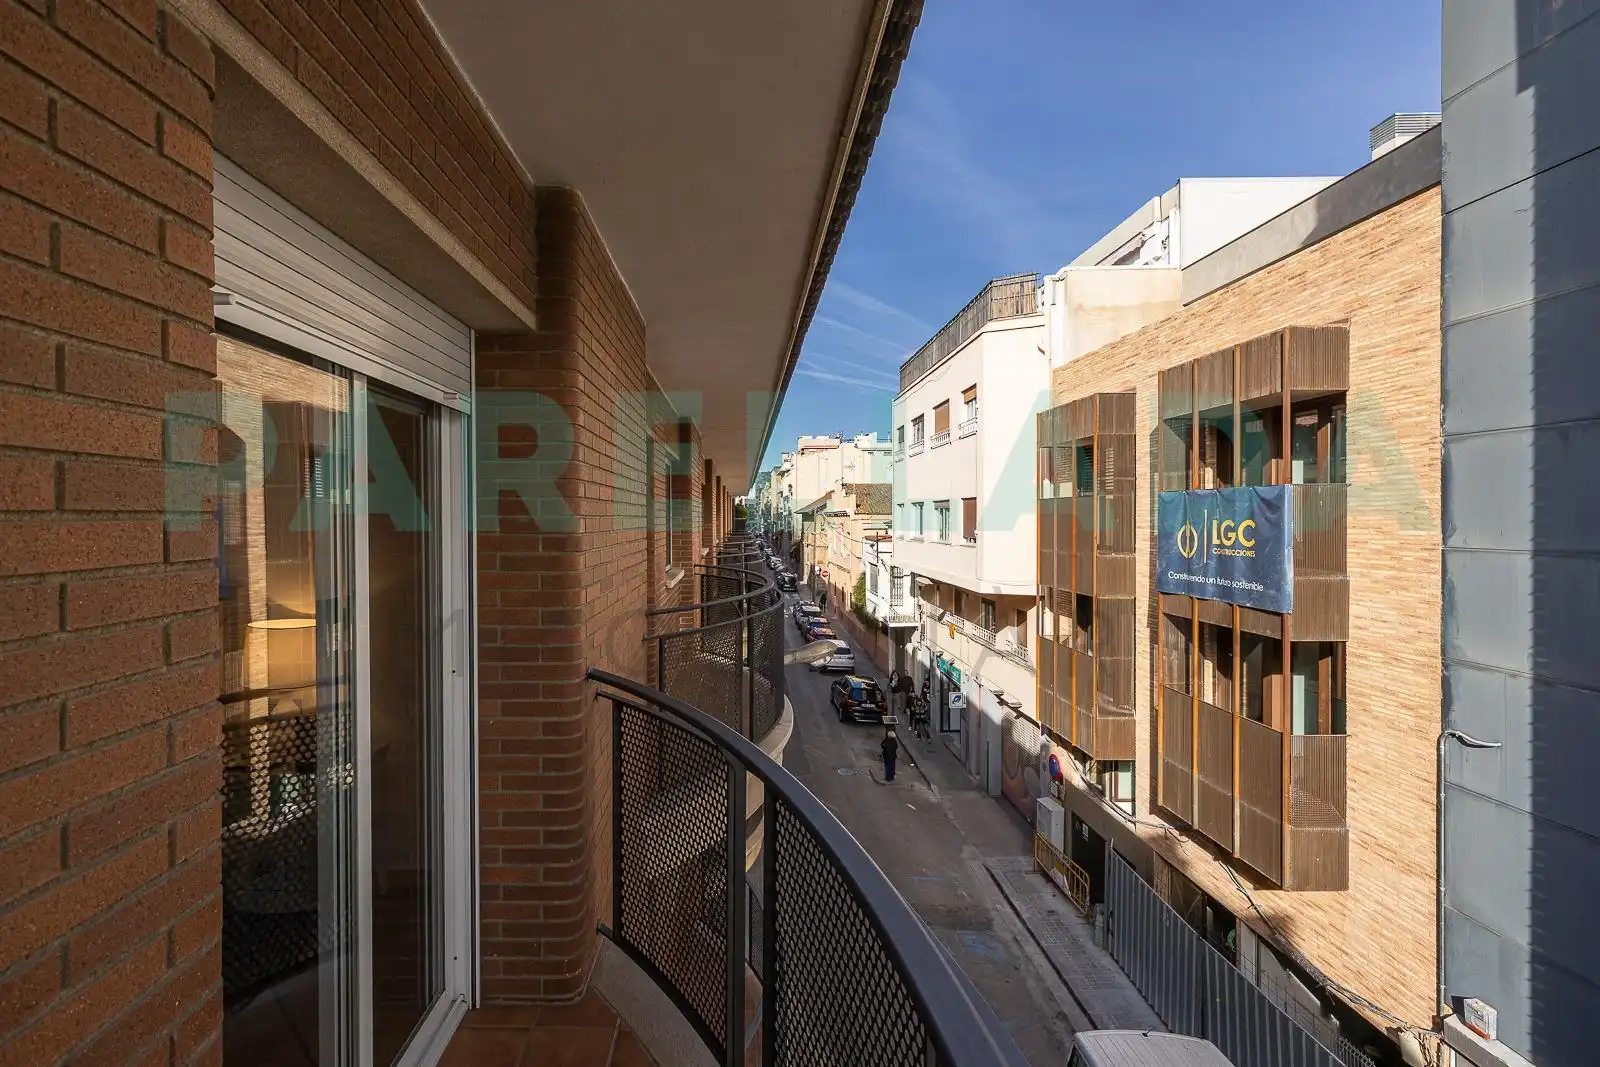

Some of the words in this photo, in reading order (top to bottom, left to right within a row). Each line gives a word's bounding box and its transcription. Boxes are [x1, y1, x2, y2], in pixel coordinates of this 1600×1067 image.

[1212, 519, 1256, 547] LGC
[1205, 576, 1216, 585] un
[1231, 579, 1264, 592] sostenible
